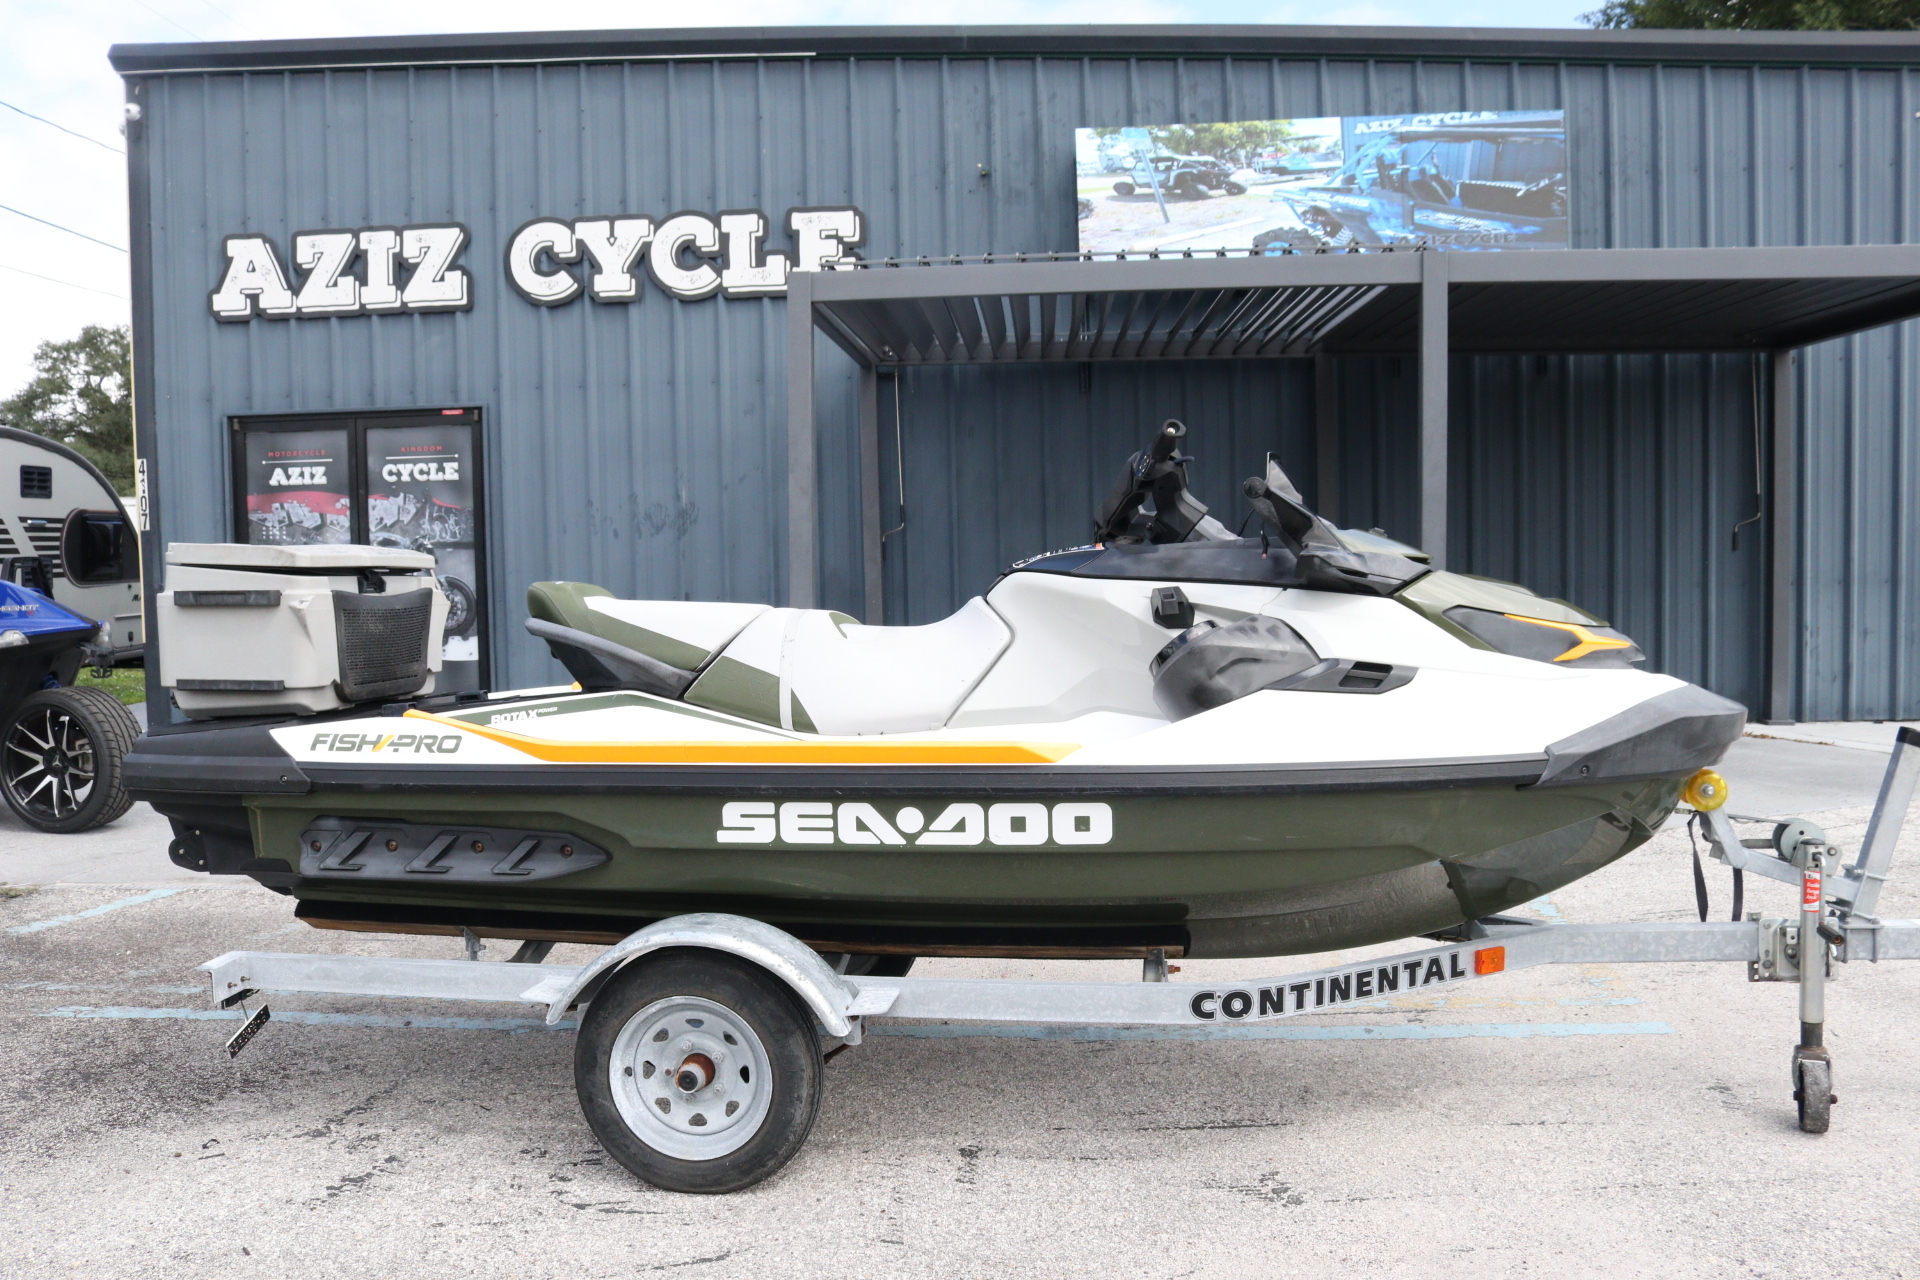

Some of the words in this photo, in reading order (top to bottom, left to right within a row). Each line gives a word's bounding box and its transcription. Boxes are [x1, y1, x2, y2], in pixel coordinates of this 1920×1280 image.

[1354, 118, 1403, 134] AZIZ
[1411, 110, 1498, 127] CYCLE
[210, 225, 468, 317] AZIZ
[508, 208, 861, 302] CYCLE
[267, 450, 326, 458] MOTORCYCLE
[401, 445, 443, 453] KINGDOM
[268, 466, 328, 486] AZIZ
[381, 462, 460, 483] CYCLE
[491, 709, 538, 725] ROTAX
[538, 706, 558, 714] POWER
[1189, 951, 1466, 1020] CONTINENTAL
